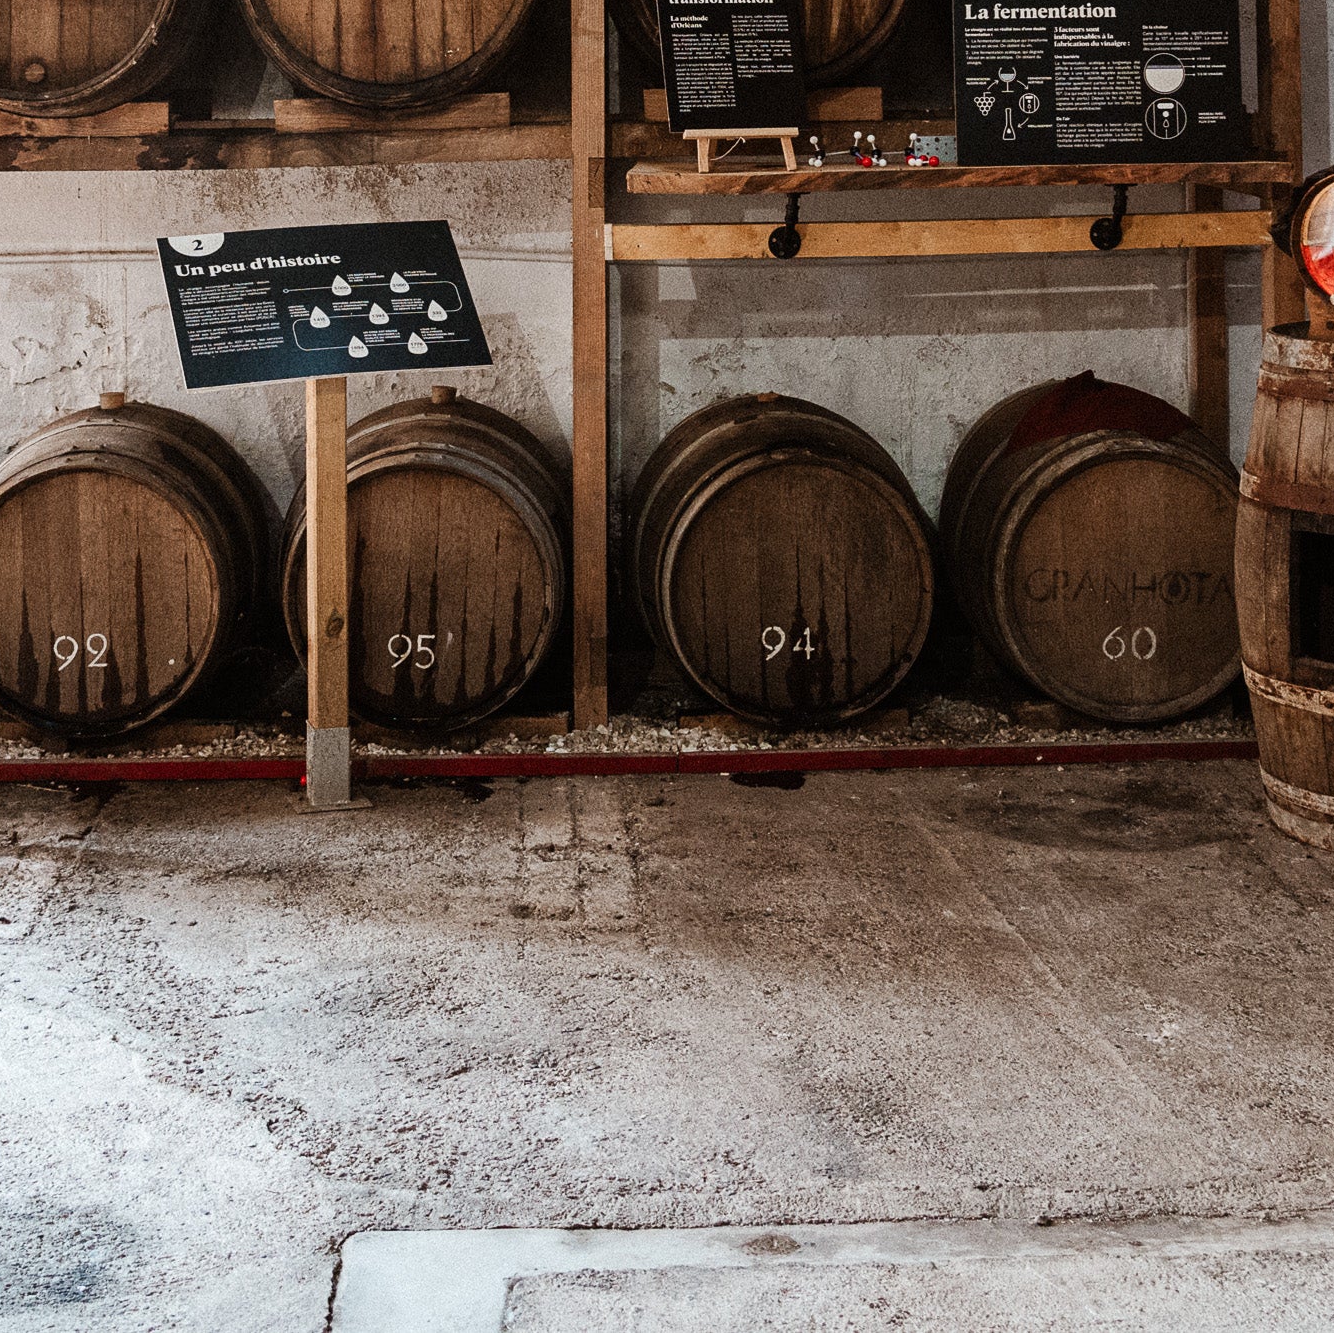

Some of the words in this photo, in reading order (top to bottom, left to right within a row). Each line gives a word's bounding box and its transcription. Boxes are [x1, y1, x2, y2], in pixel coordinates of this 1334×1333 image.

[964, 4, 989, 20] La
[993, 3, 1117, 20] fermentation
[193, 239, 204, 251] 2
[174, 264, 205, 277] Un
[208, 262, 246, 277] peu
[249, 253, 342, 271] d'histoire
[53, 633, 108, 670] 92
[387, 634, 436, 669] 95
[761, 626, 816, 660] 94
[1102, 625, 1157, 661] 60
